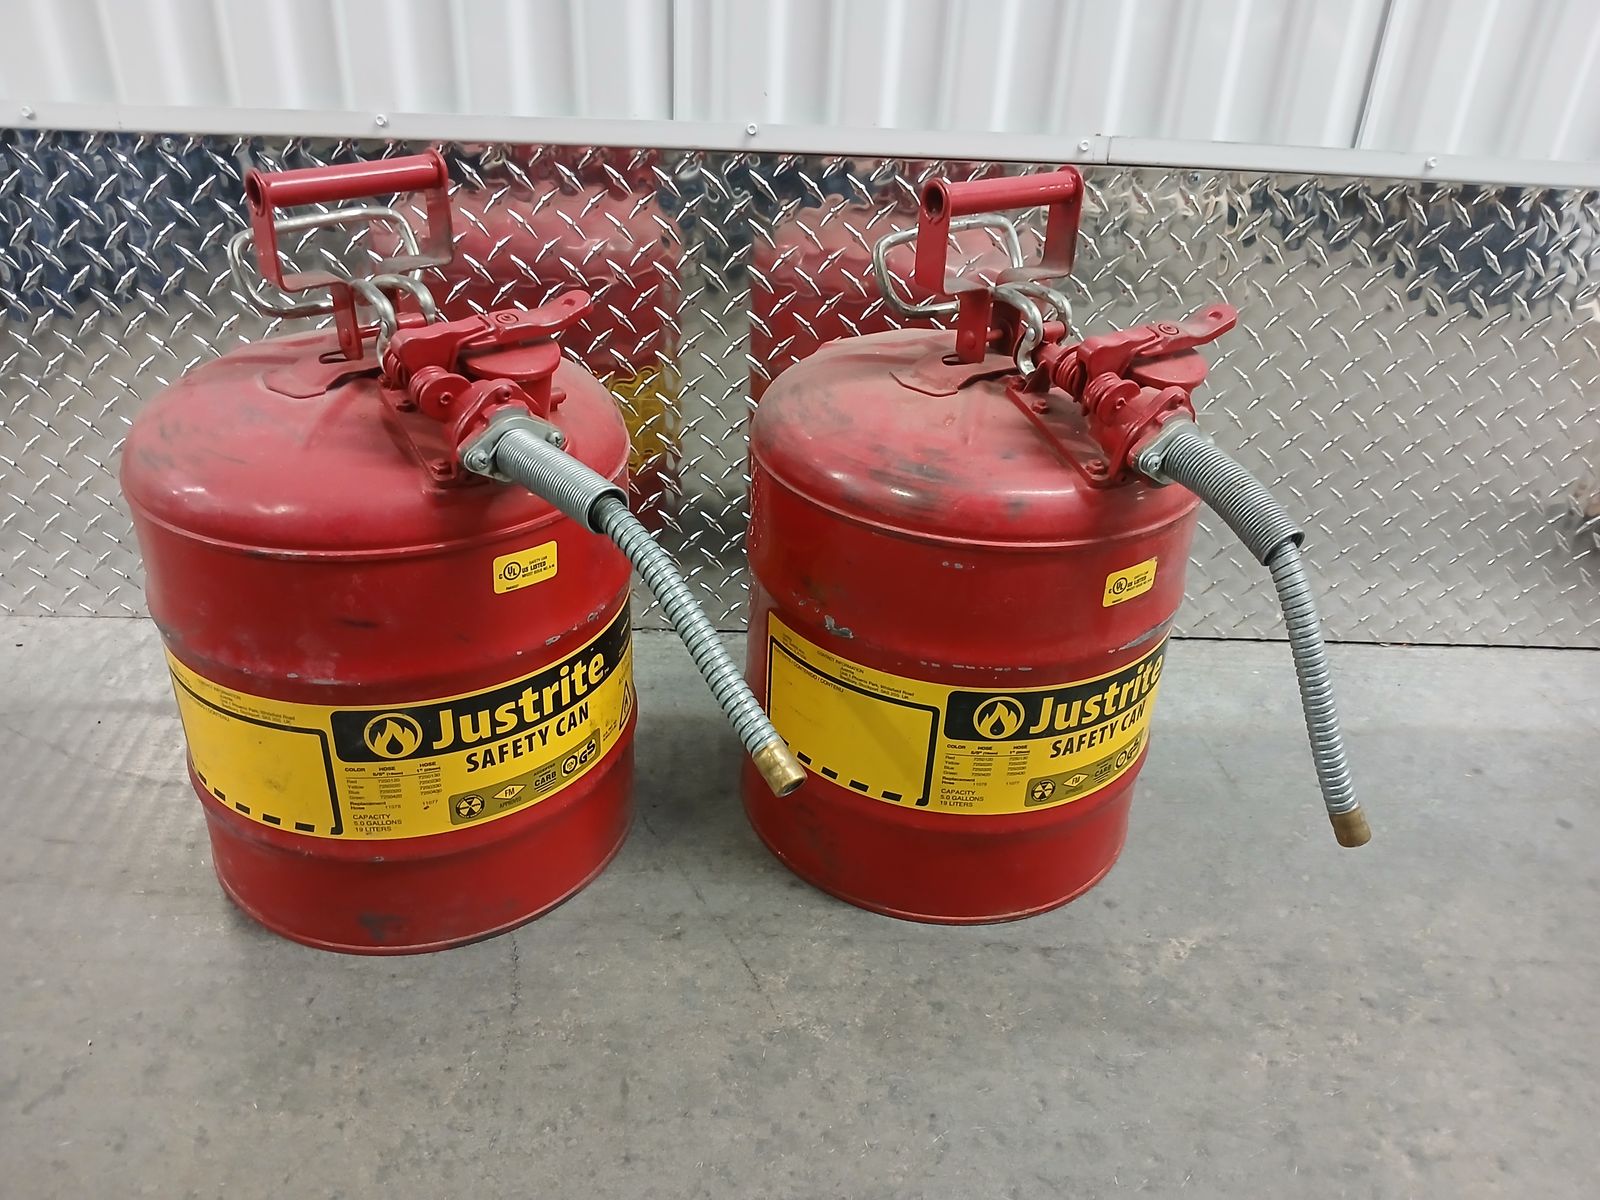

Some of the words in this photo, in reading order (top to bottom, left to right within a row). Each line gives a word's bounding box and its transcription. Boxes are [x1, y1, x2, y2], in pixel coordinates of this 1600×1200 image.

[432, 652, 604, 750] Justrite
[820, 678, 844, 692] CONTENU
[1029, 655, 1163, 734] Justrite
[466, 725, 549, 772] SAFETY
[556, 702, 589, 737] CAN
[1050, 720, 1118, 758] SAFETY
[1121, 700, 1146, 732] CAN
[580, 740, 596, 764] GS
[504, 787, 515, 797] FM
[534, 771, 556, 786] CARB
